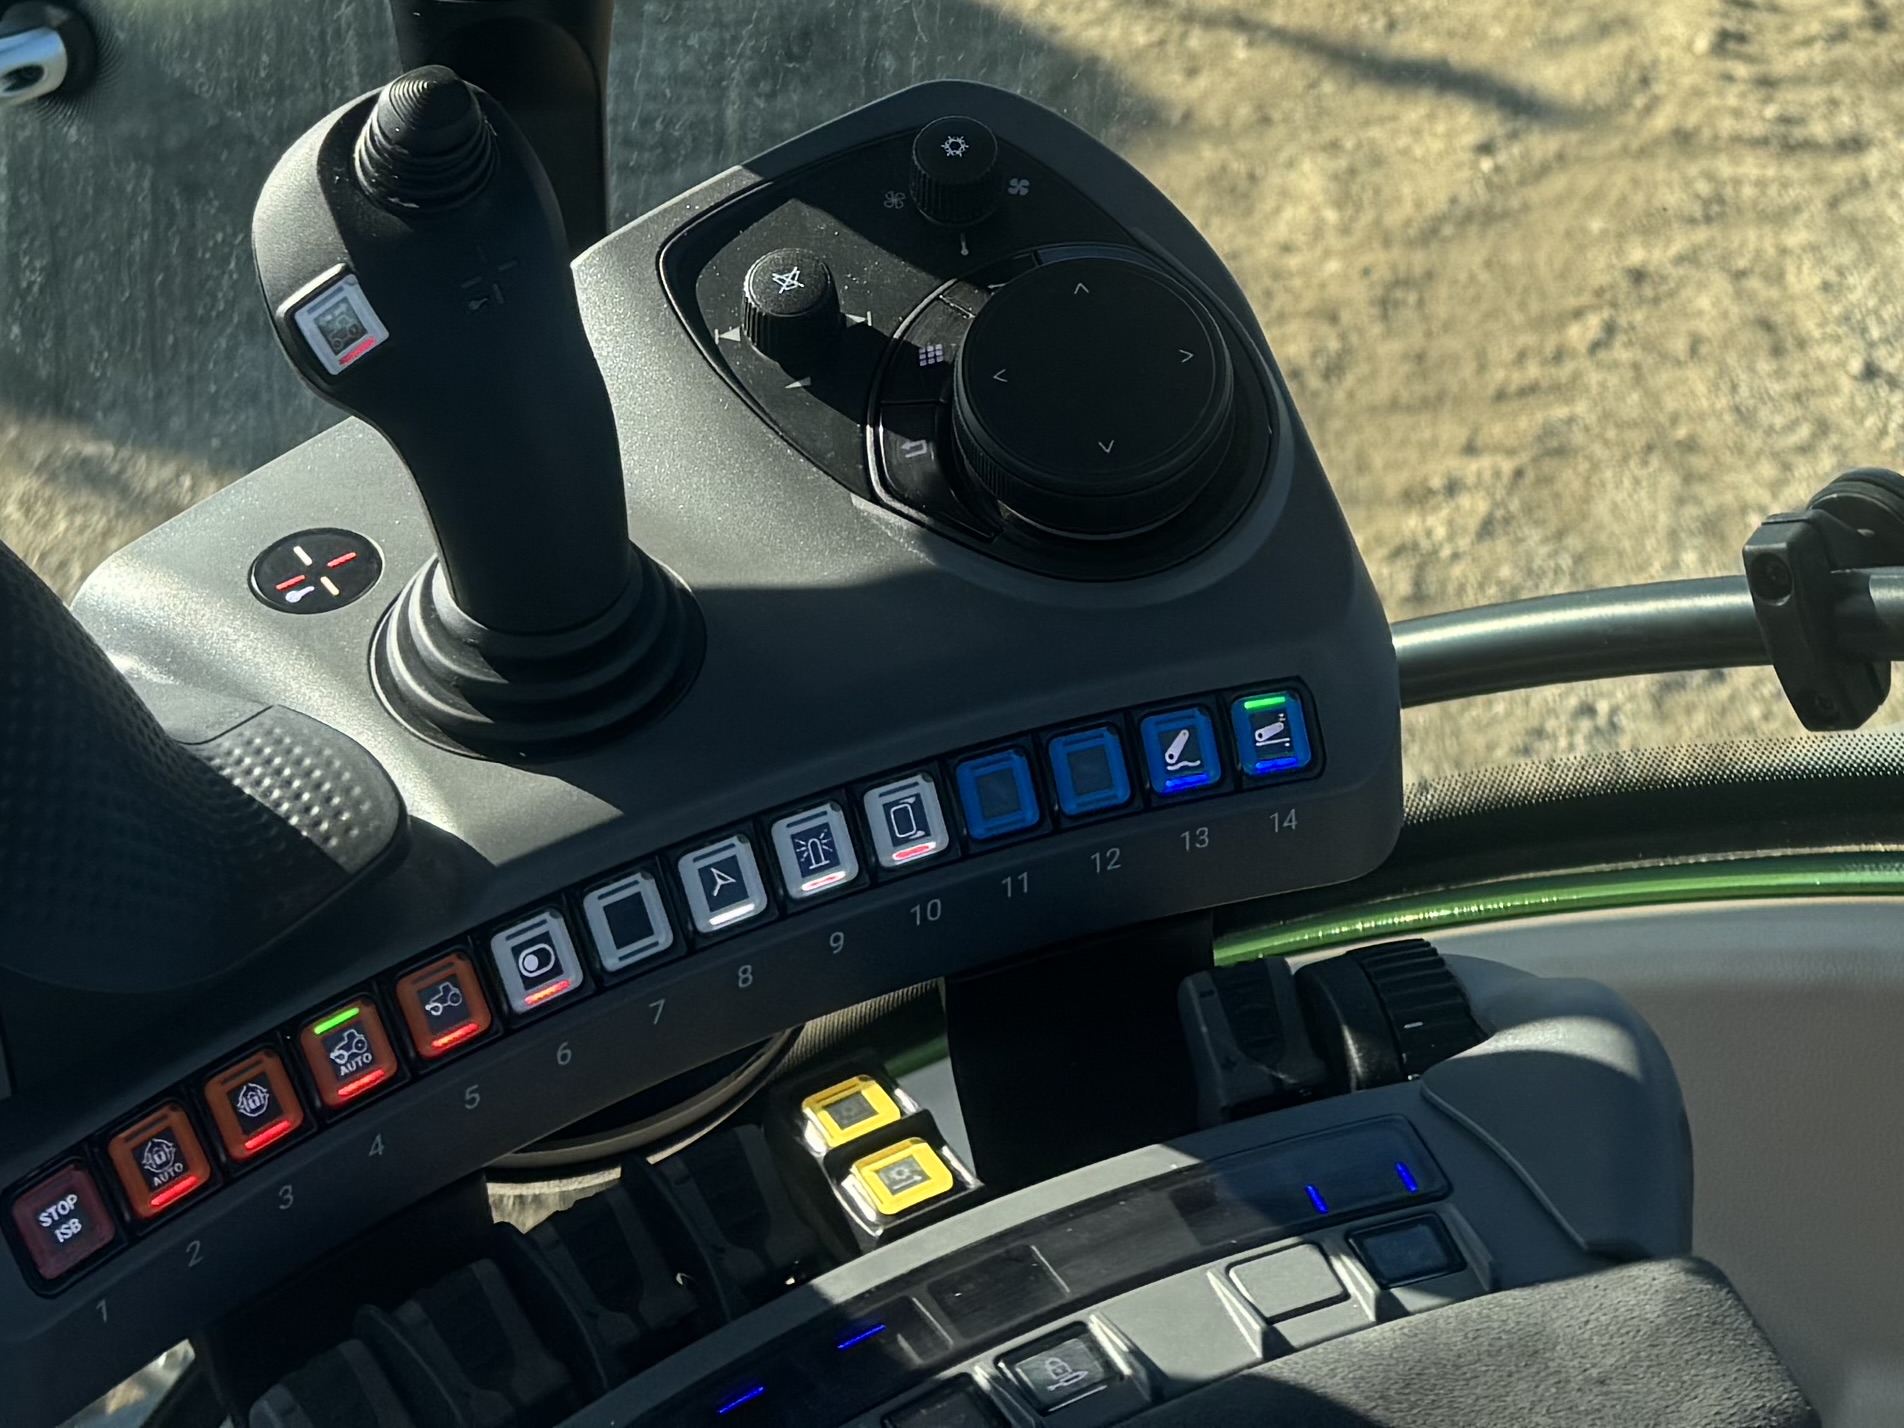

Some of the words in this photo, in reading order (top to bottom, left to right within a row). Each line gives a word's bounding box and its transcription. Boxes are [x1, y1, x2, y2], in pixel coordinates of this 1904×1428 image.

[1268, 807, 1299, 834] 14
[1179, 826, 1210, 853] 13
[1090, 847, 1123, 875] 12
[1000, 871, 1030, 899] 11
[908, 897, 942, 927] 10
[828, 930, 846, 955] 9
[737, 964, 753, 989] 8
[648, 998, 667, 1025] 7
[339, 1052, 373, 1076] AUTO
[555, 1041, 573, 1066] 6
[464, 1084, 481, 1111] 5
[369, 1133, 385, 1158] 4
[153, 1161, 184, 1188] AUTO
[39, 1193, 79, 1229] STOP
[278, 1185, 295, 1210] 3
[55, 1217, 82, 1243] ISB
[185, 1240, 204, 1267] 2
[95, 1300, 108, 1324] 1
